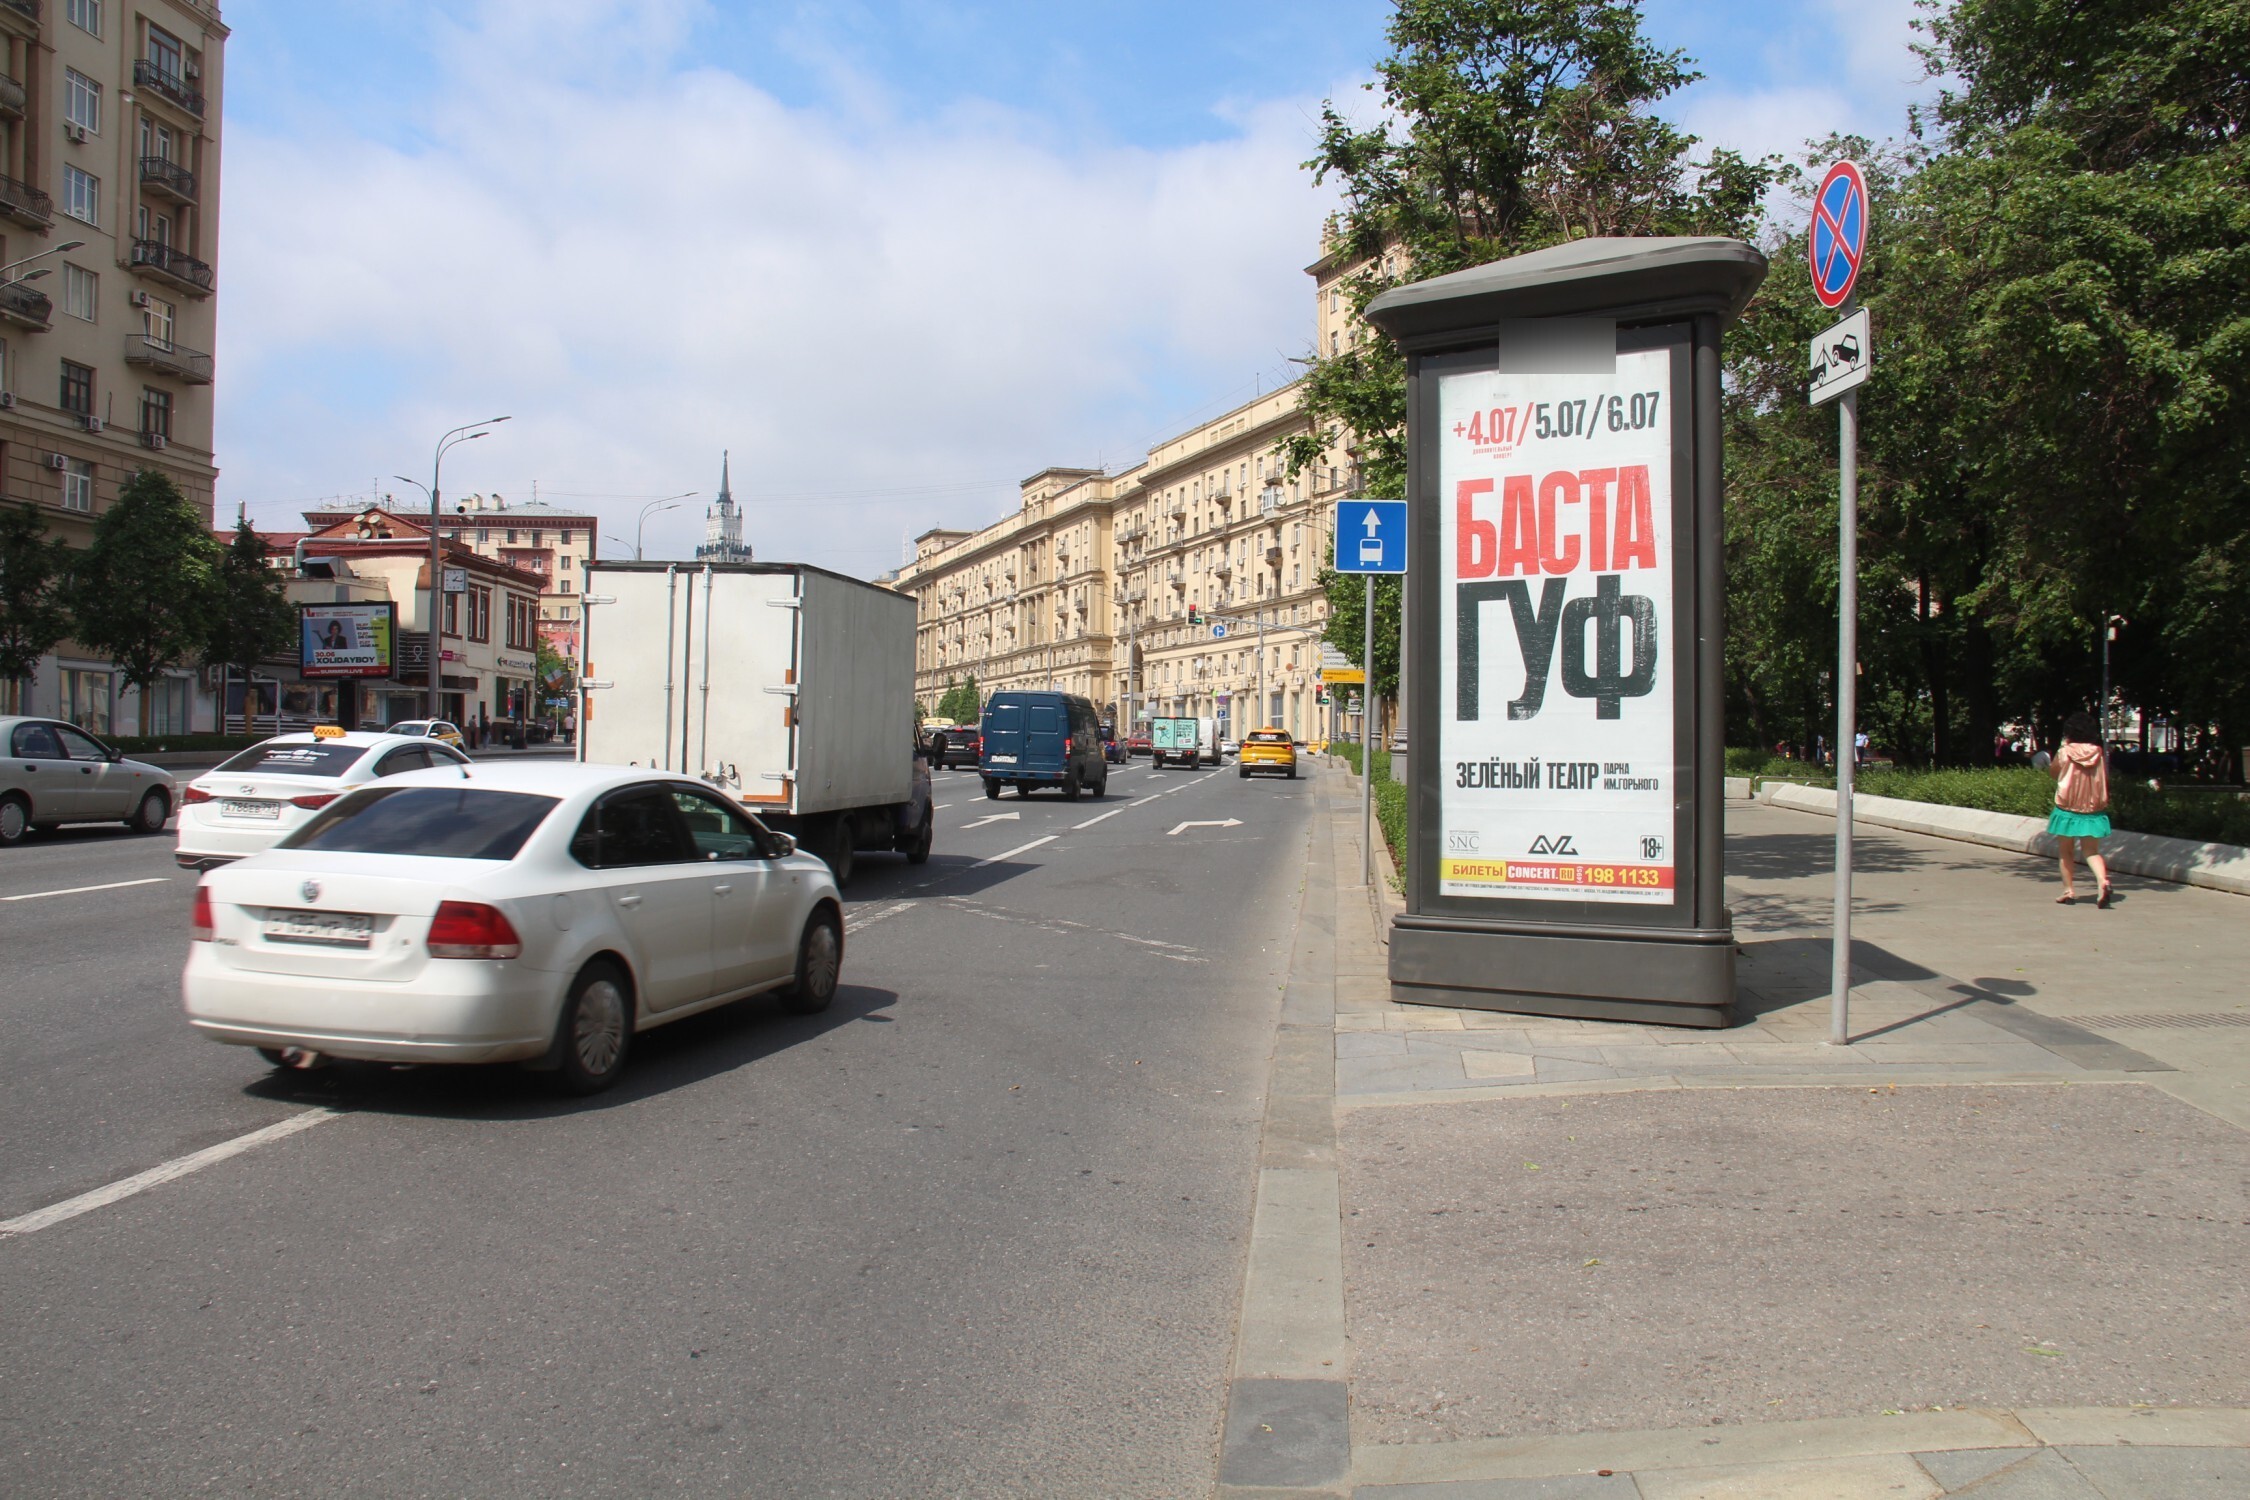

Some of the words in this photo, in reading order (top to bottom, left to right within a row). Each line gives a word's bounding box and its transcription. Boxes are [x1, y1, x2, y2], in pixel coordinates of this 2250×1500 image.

[1456, 464, 1657, 579] БАСТА
[1456, 574, 1658, 721] ГУФ
[316, 656, 376, 665] XOLIDAYBOY
[1456, 757, 1540, 789] ЗЕЛЁНЫЙ
[1546, 762, 1599, 790] ТЕАТР
[1603, 762, 1630, 775] ПАРКА
[1603, 777, 1659, 791] ИМ.ГОРЬКОГО
[1448, 835, 1480, 850] SNC
[1641, 837, 1663, 859] 18+
[1452, 864, 1503, 877] БИЛЕТЫ
[1584, 867, 1614, 884] 198
[1620, 868, 1659, 886] 1133
